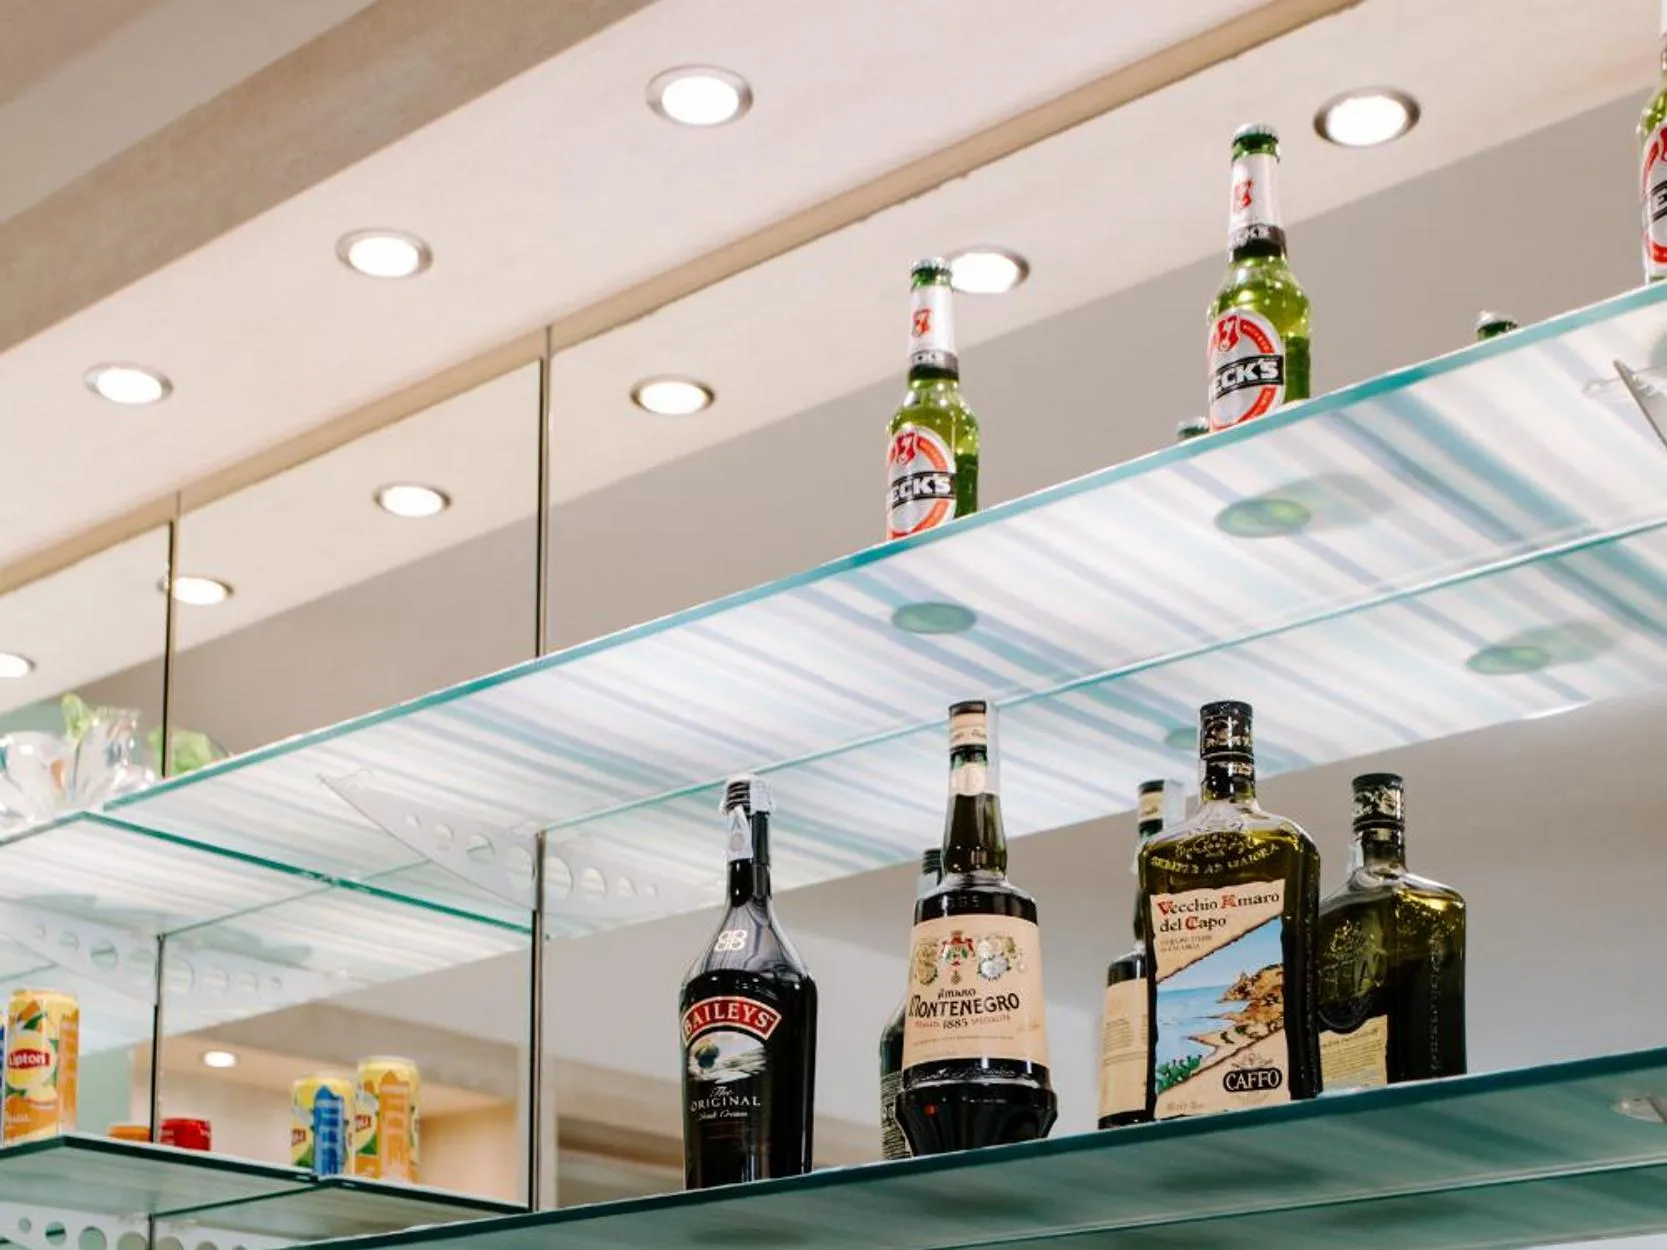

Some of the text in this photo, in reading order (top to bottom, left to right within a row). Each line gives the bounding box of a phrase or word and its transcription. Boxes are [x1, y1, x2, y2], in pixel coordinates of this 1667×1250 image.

[1215, 357, 1279, 396] ECK'S
[893, 473, 952, 503] ECK'S
[1157, 898, 1218, 915] Vecchio
[1160, 915, 1226, 932] del Capo
[908, 992, 1020, 1018] MONTENEGRO
[683, 1001, 769, 1036] BAILEYS
[1225, 1068, 1280, 1092] CAFFO
[691, 1096, 761, 1113] ORIGINAL
